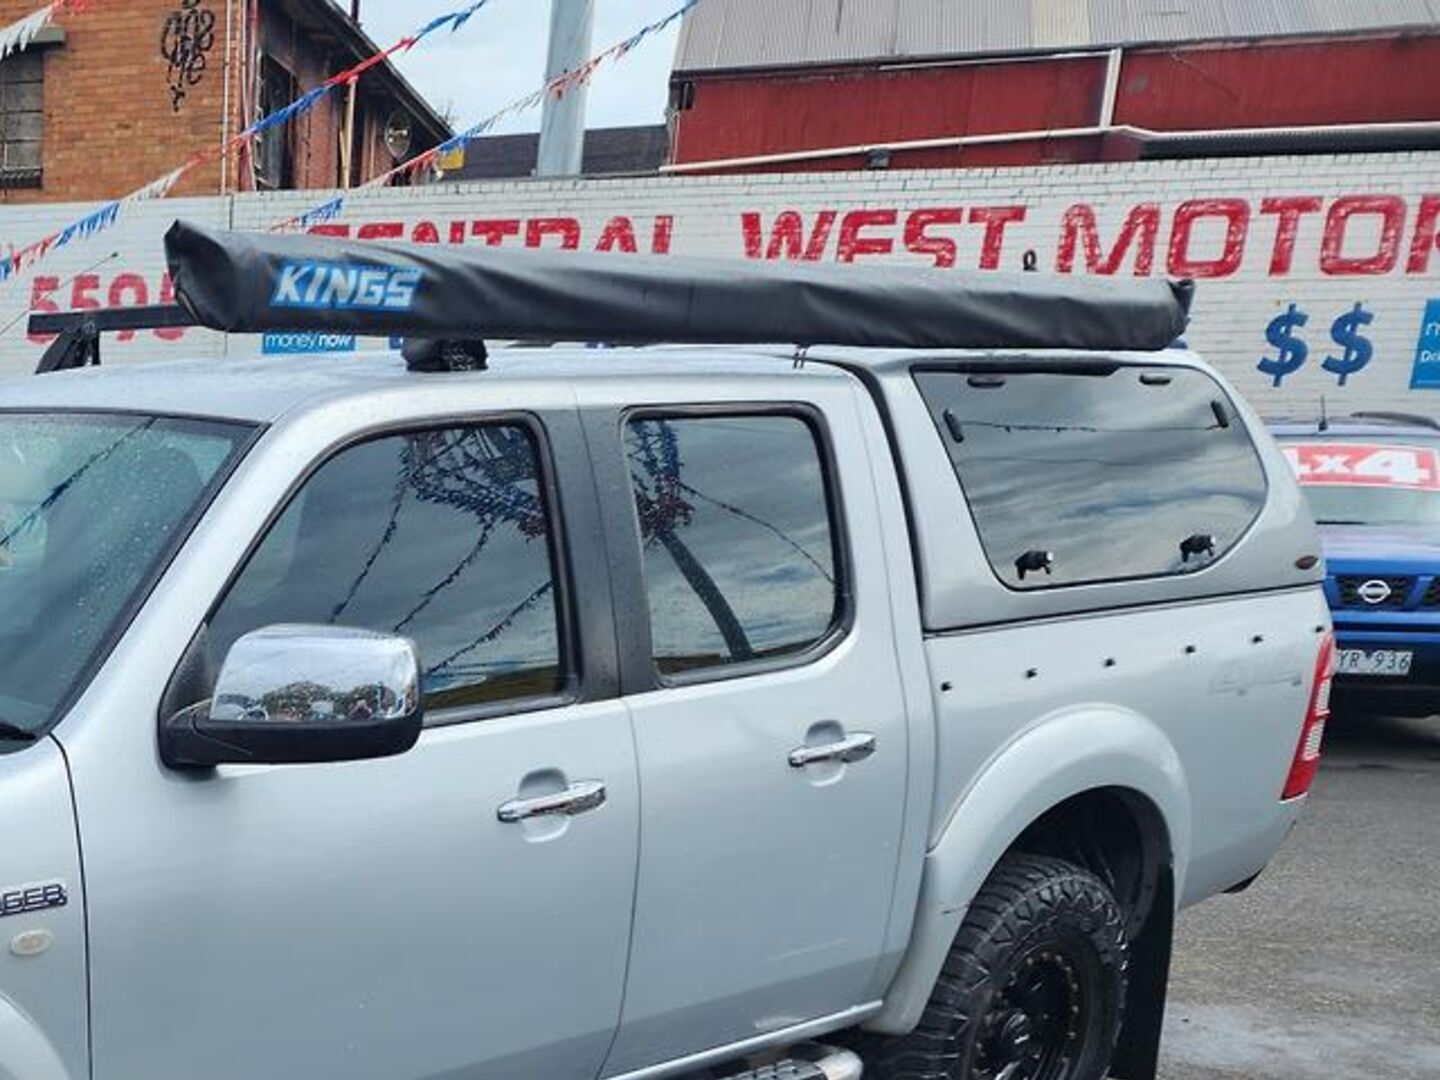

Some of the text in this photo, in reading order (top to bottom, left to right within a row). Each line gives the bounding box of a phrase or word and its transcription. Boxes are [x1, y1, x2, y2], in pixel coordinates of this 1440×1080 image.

[304, 214, 674, 255] TRAL
[741, 206, 1027, 270] WEST
[276, 263, 418, 306] KINGS
